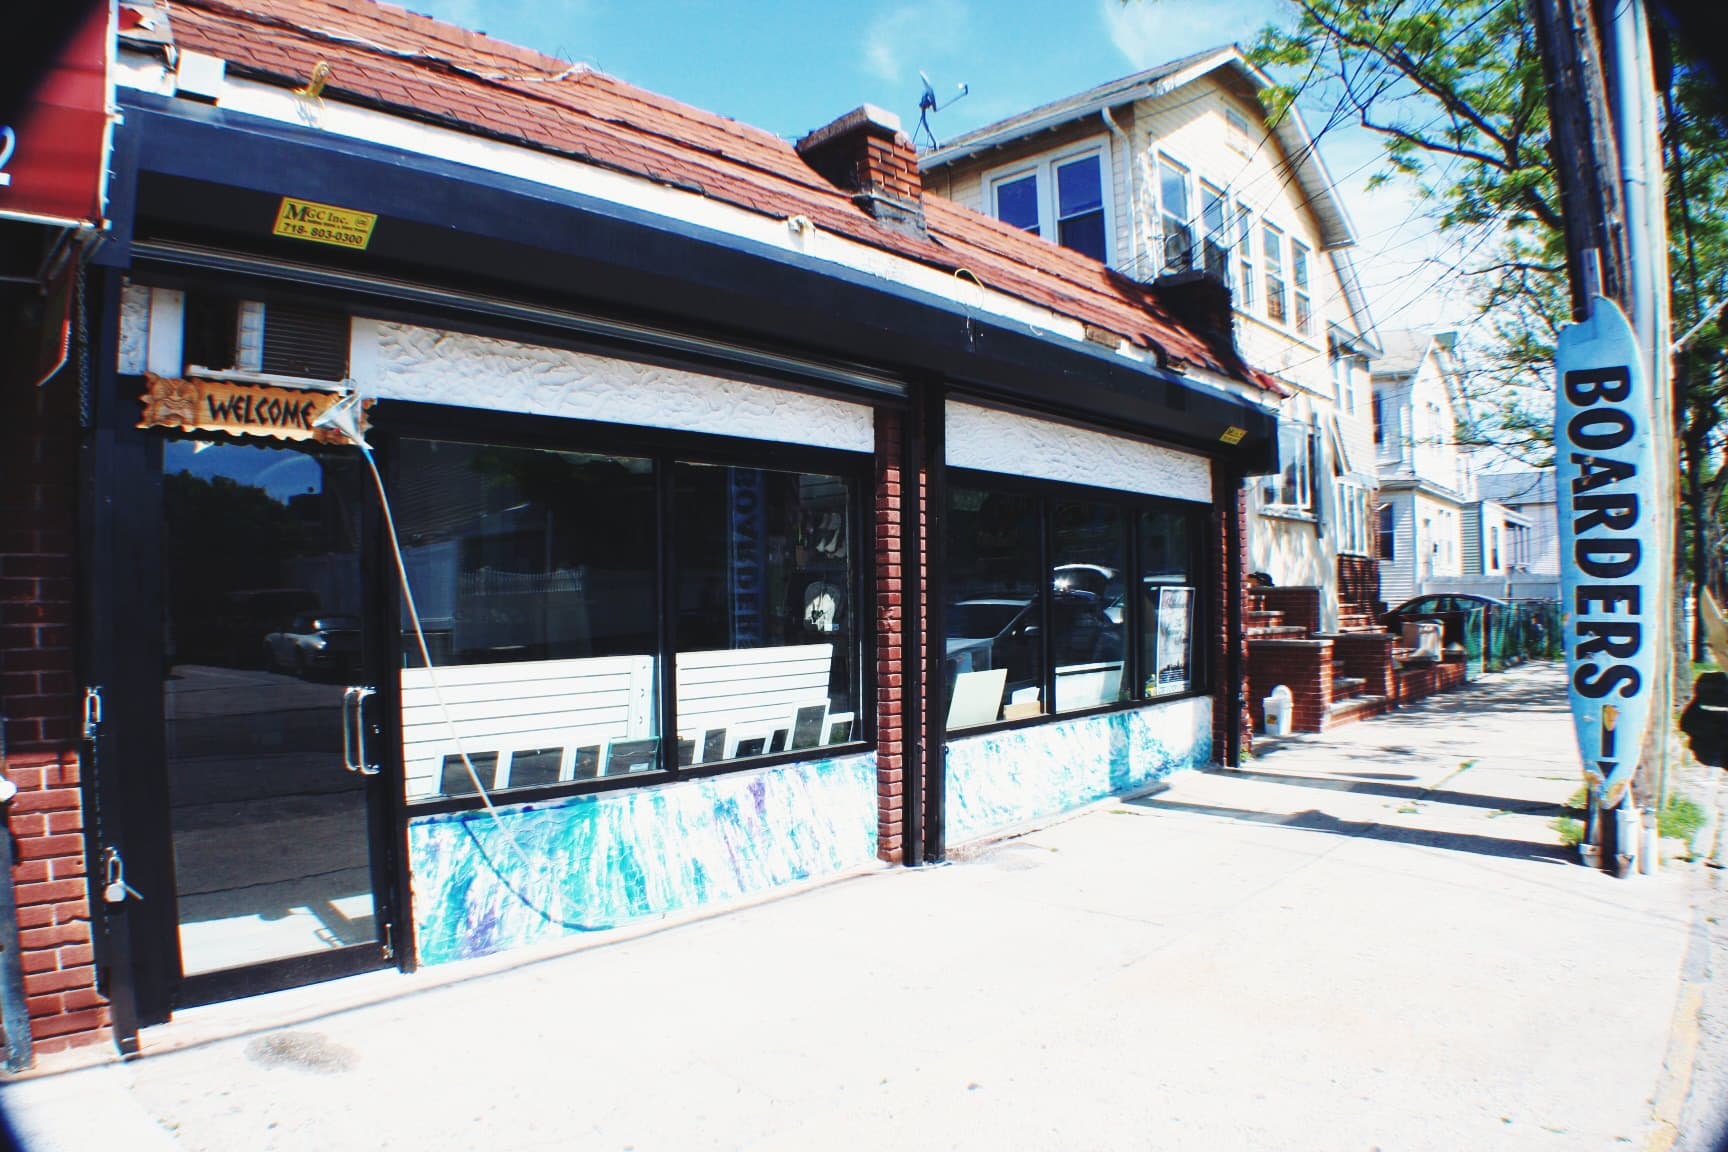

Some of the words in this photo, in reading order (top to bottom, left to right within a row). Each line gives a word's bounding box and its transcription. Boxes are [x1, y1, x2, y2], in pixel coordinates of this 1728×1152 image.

[283, 203, 326, 222] MGC
[328, 213, 349, 225] Inc.
[207, 394, 316, 429] WELCOME
[1564, 365, 1643, 699] BOARDERS
